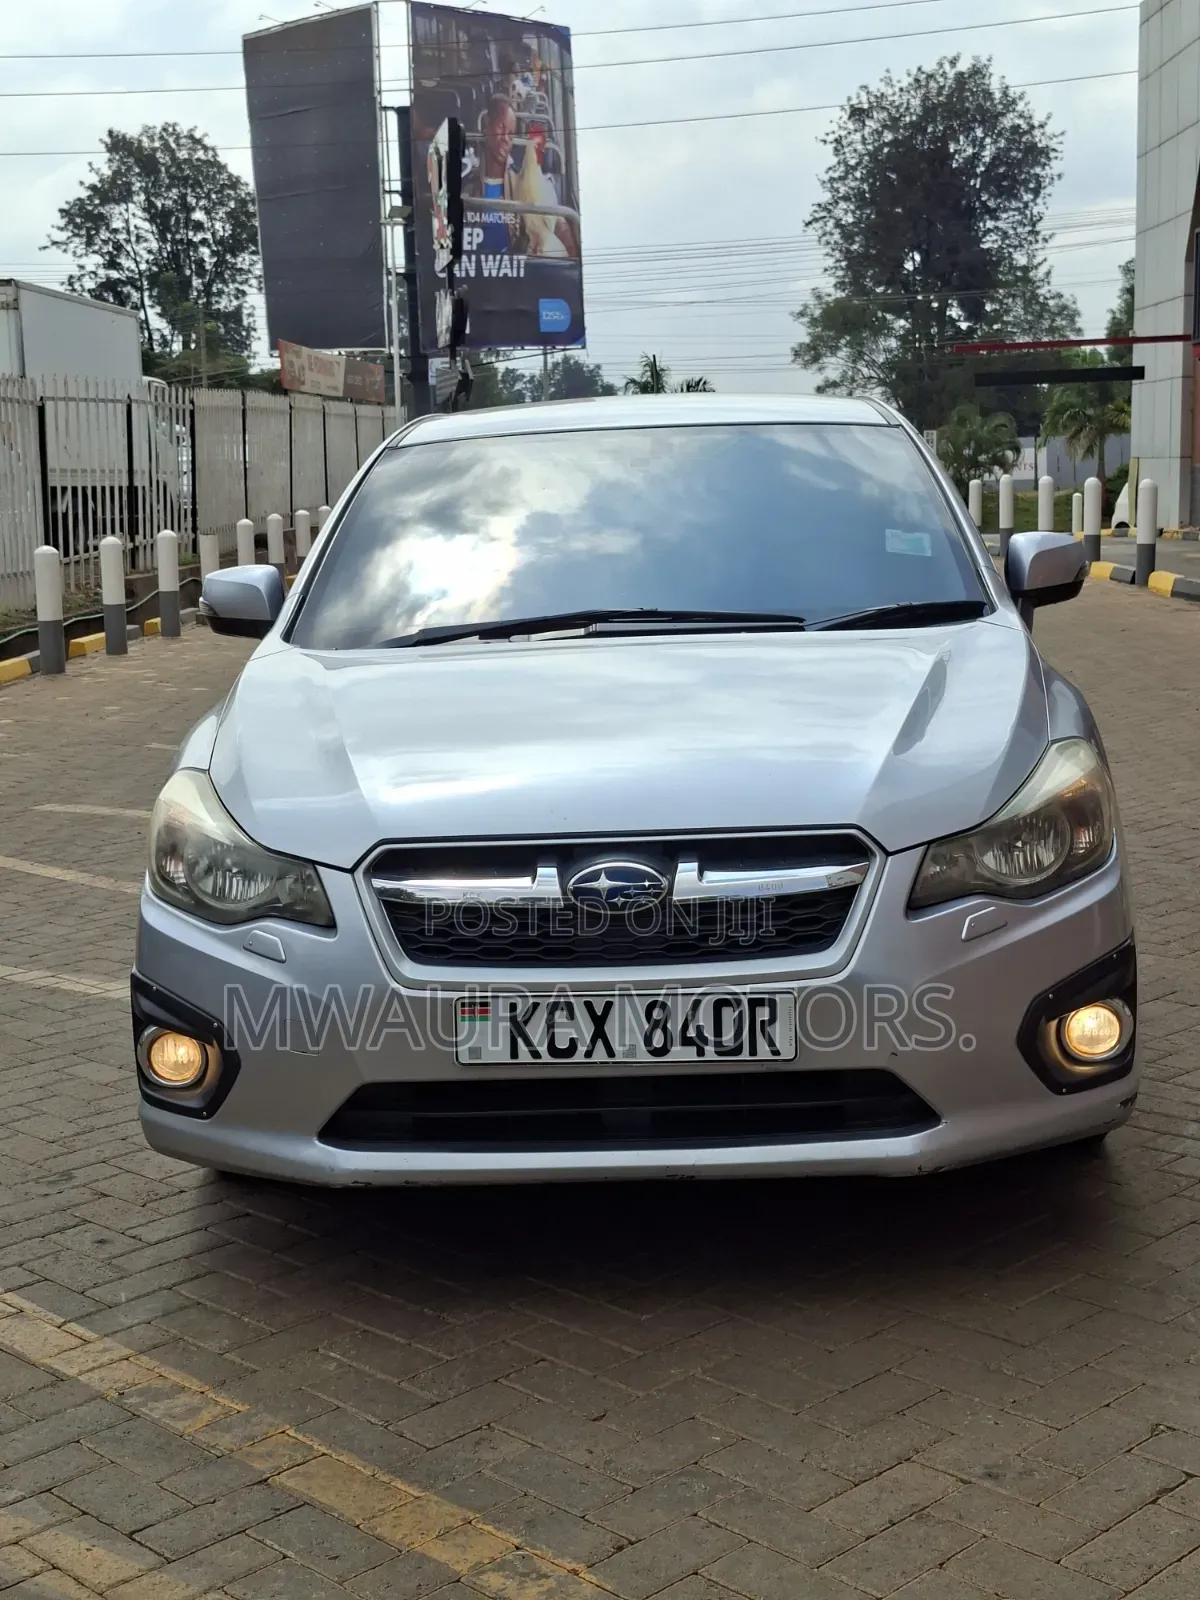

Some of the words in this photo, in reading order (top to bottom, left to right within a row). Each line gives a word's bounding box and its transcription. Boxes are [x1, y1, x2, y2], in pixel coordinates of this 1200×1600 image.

[481, 211, 516, 224] MATCHES
[462, 227, 484, 251] EP
[480, 254, 527, 278] WAIT
[508, 999, 617, 1060] KCX
[643, 997, 782, 1058] 840R
